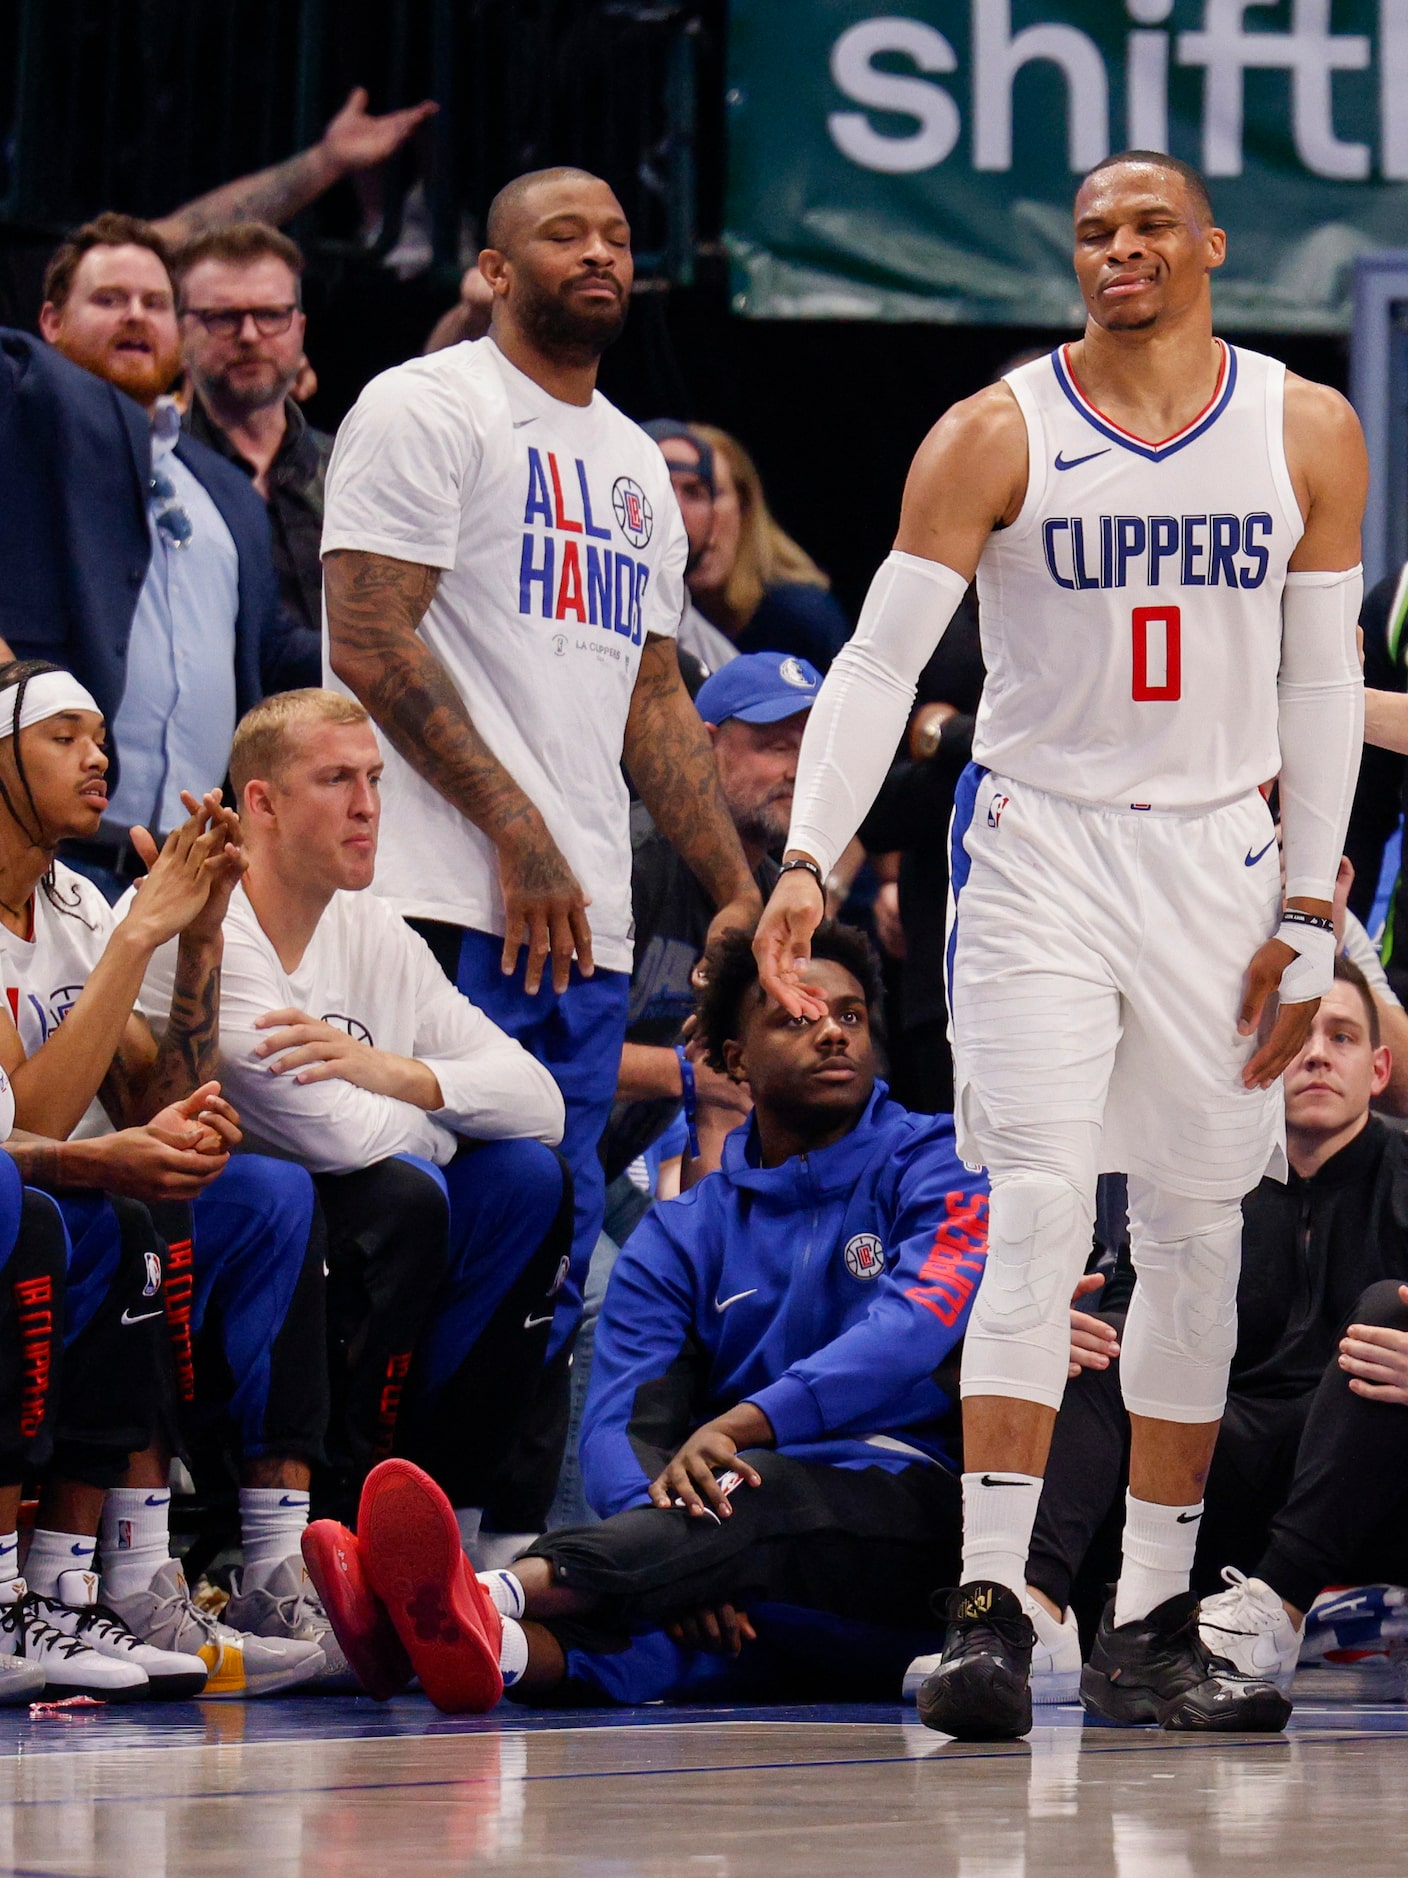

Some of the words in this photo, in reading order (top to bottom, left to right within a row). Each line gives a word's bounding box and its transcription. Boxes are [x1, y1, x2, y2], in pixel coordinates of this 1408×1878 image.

[524, 446, 612, 541] ALL
[519, 532, 650, 647] HANDS
[1042, 512, 1273, 590] CLIPPERS
[1131, 606, 1181, 702] 0
